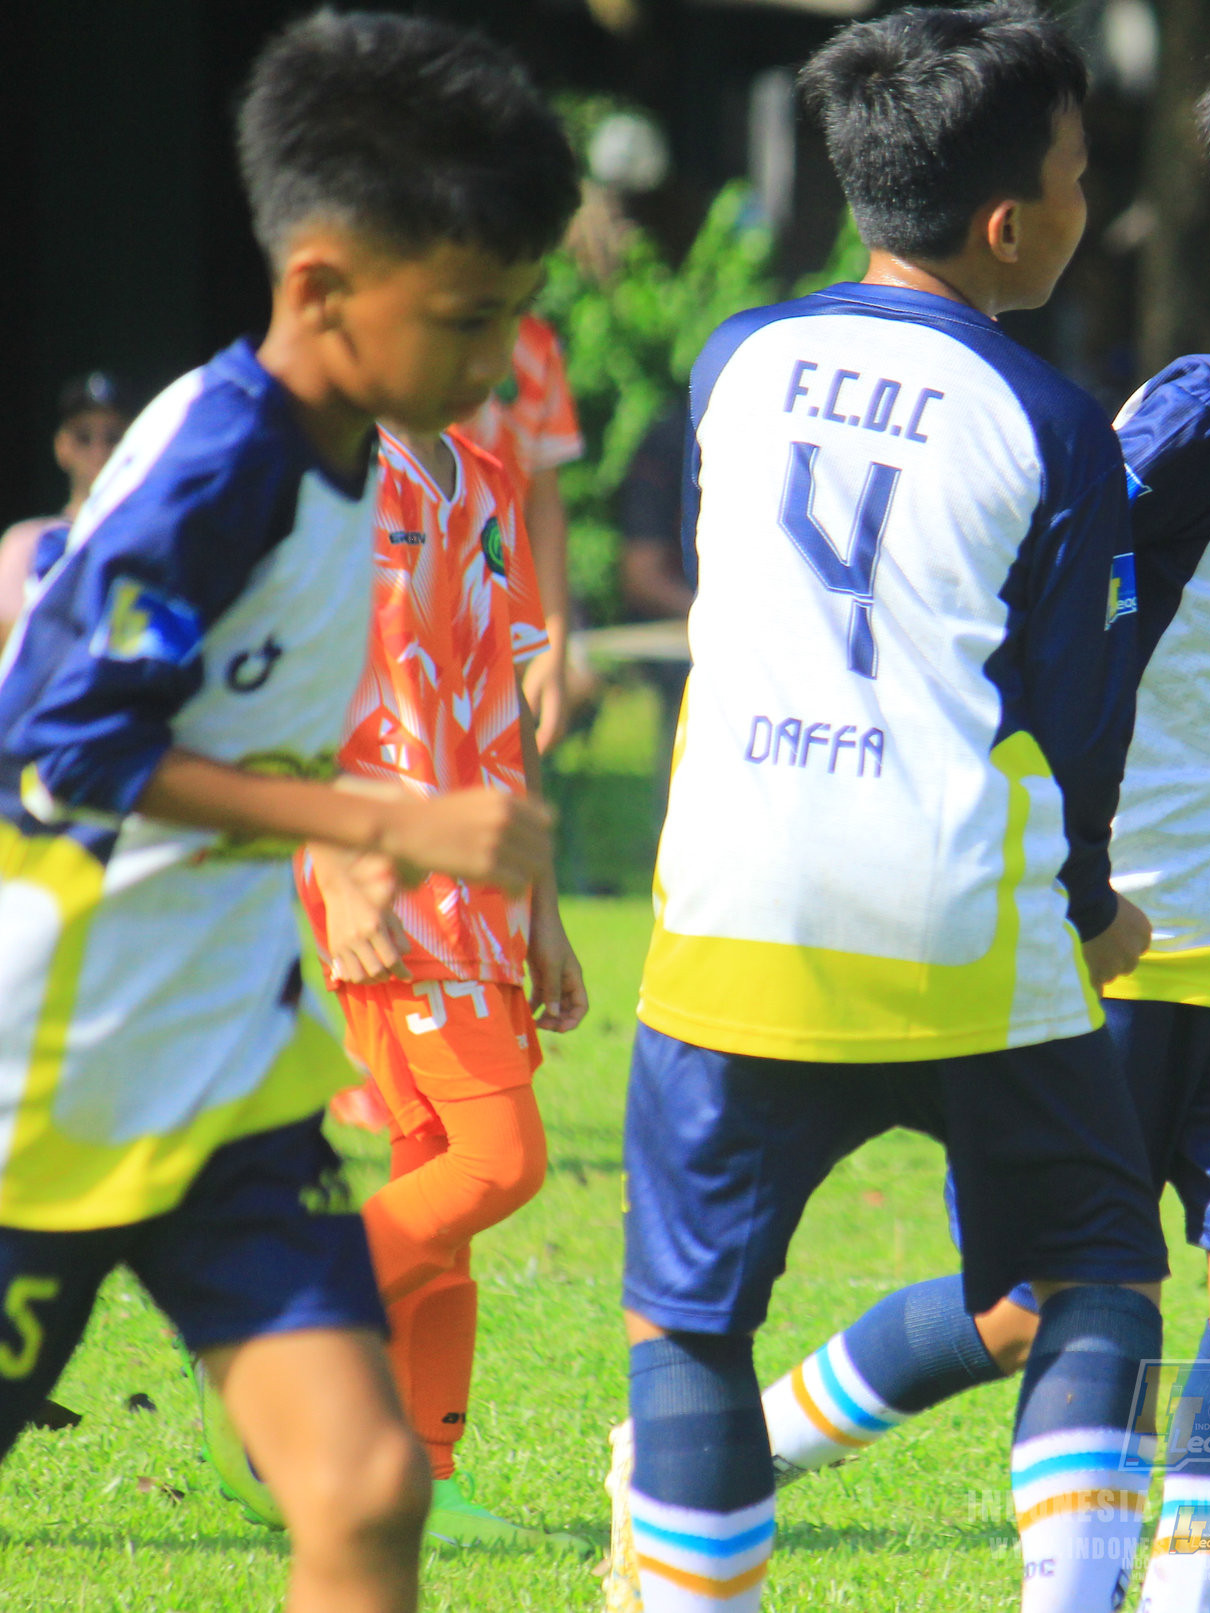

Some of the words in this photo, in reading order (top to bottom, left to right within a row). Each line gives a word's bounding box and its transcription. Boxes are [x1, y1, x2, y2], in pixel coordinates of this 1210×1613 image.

[777, 440, 901, 680] 4
[744, 714, 884, 778] DAFFA
[0, 1274, 60, 1382] 5
